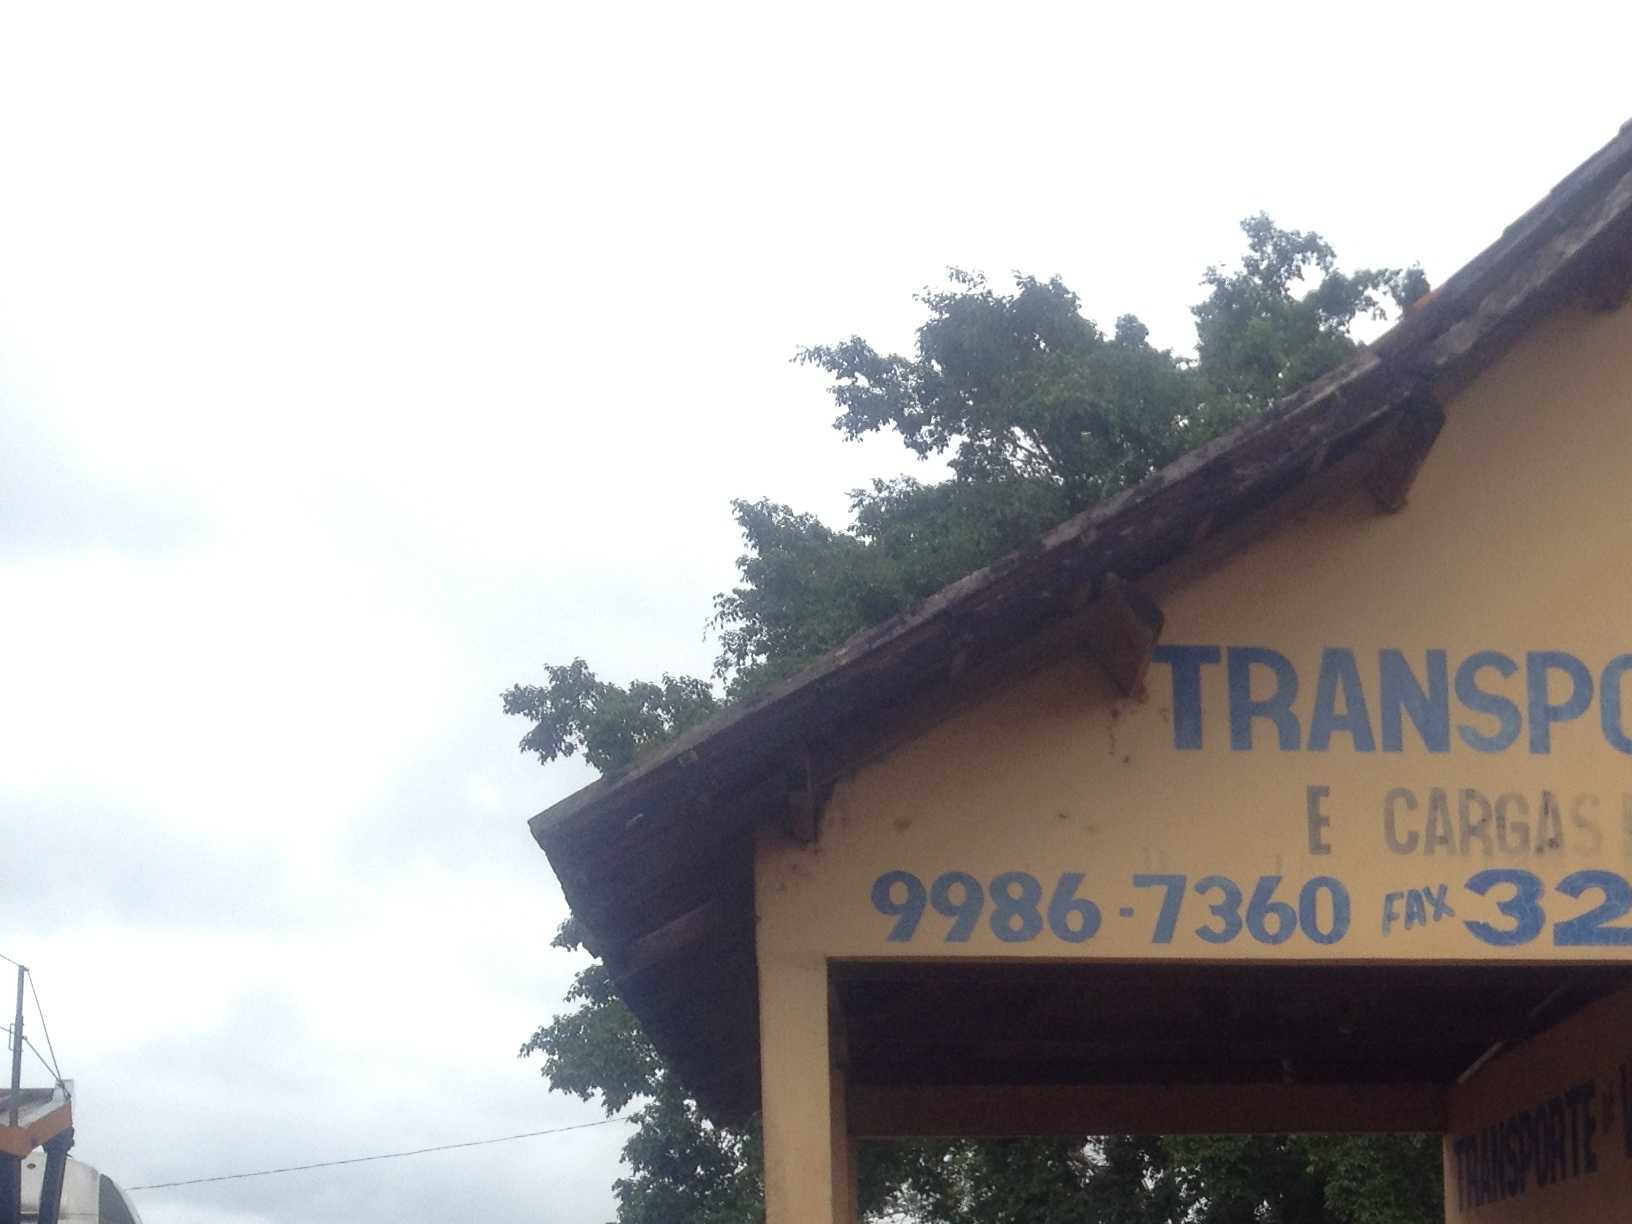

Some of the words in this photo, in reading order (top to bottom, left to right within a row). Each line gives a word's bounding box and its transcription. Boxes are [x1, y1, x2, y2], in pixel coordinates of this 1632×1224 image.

[1306, 785, 1331, 855] E
[1384, 787, 1602, 859] CARGAS
[1382, 883, 1456, 936] FAX
[1454, 1081, 1598, 1211] TRANSPORTE
